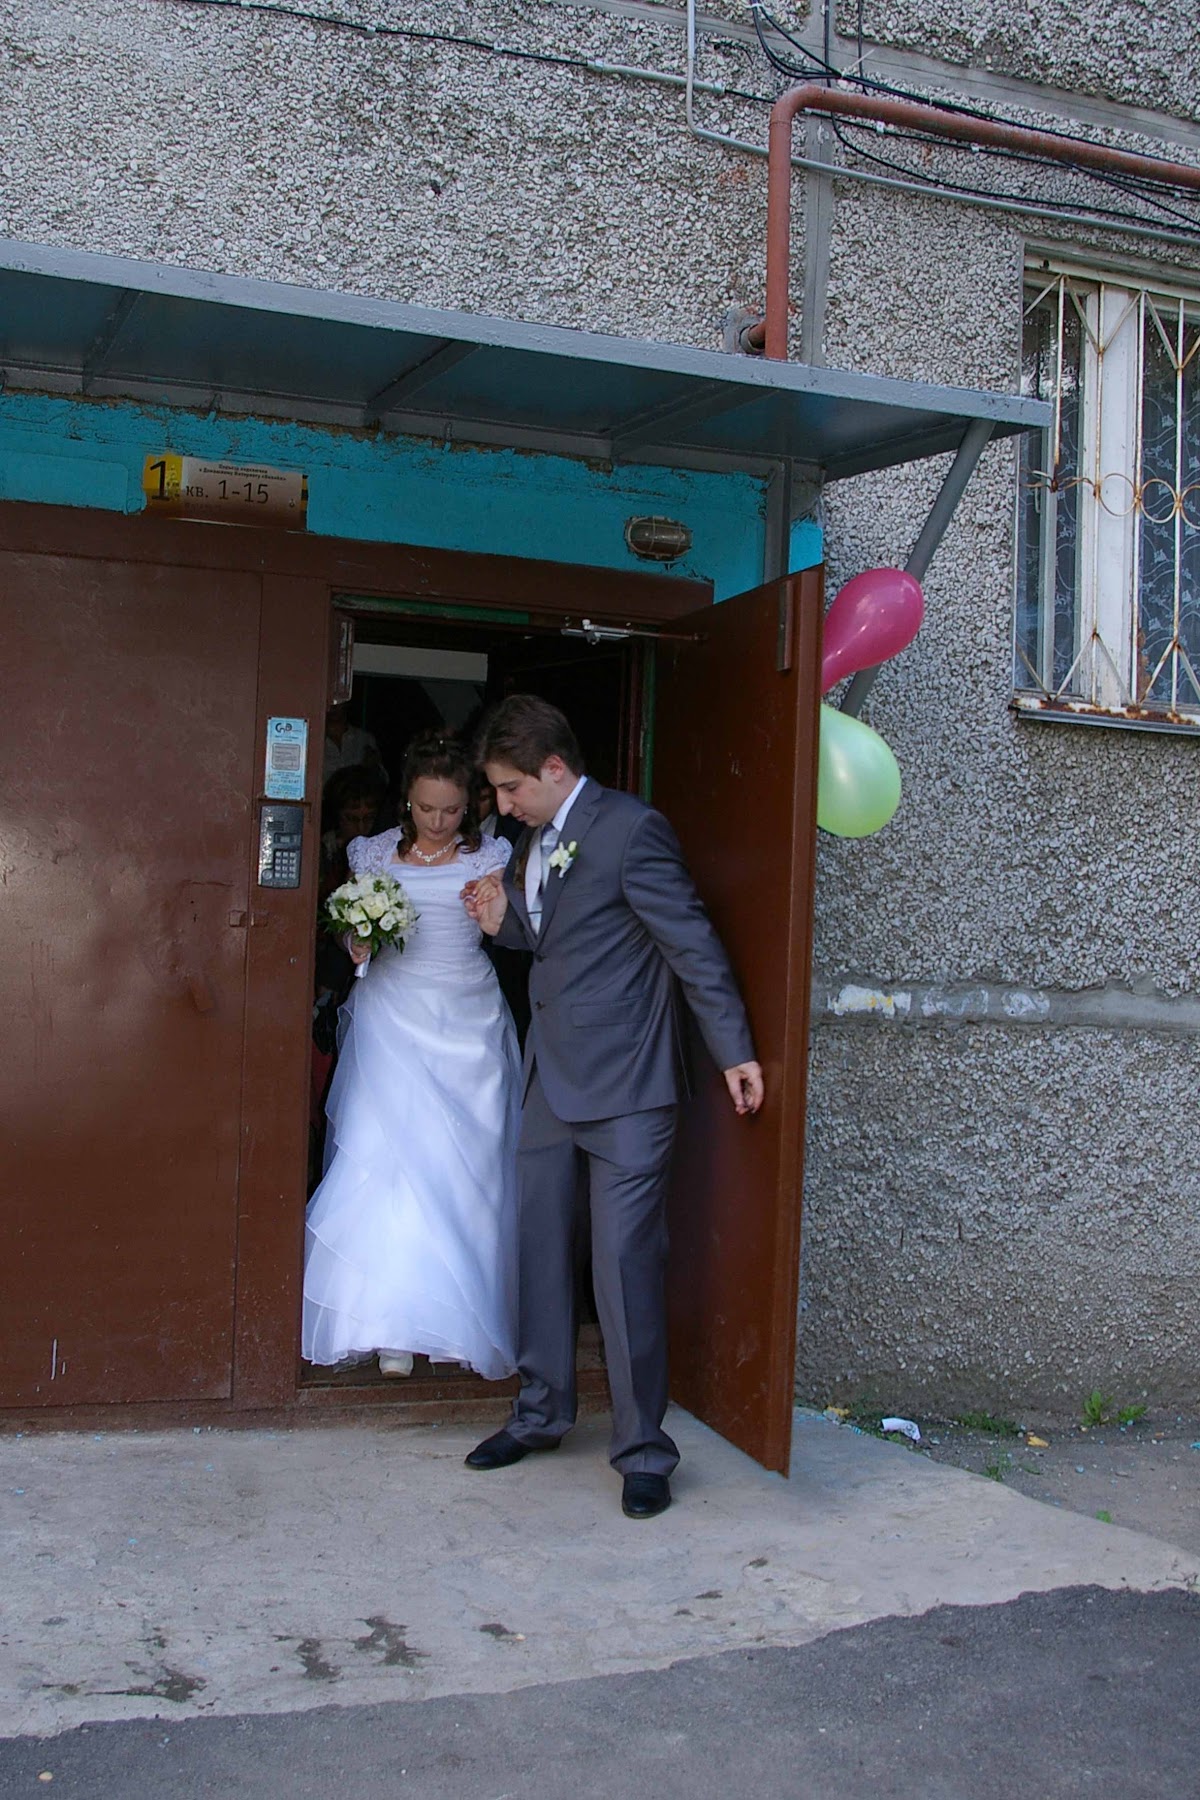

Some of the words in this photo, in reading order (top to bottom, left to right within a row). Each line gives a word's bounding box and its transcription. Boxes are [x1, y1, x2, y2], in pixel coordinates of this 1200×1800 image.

[150, 460, 170, 501] 1
[186, 485, 209, 498] кв.
[218, 479, 269, 504] 1-15
